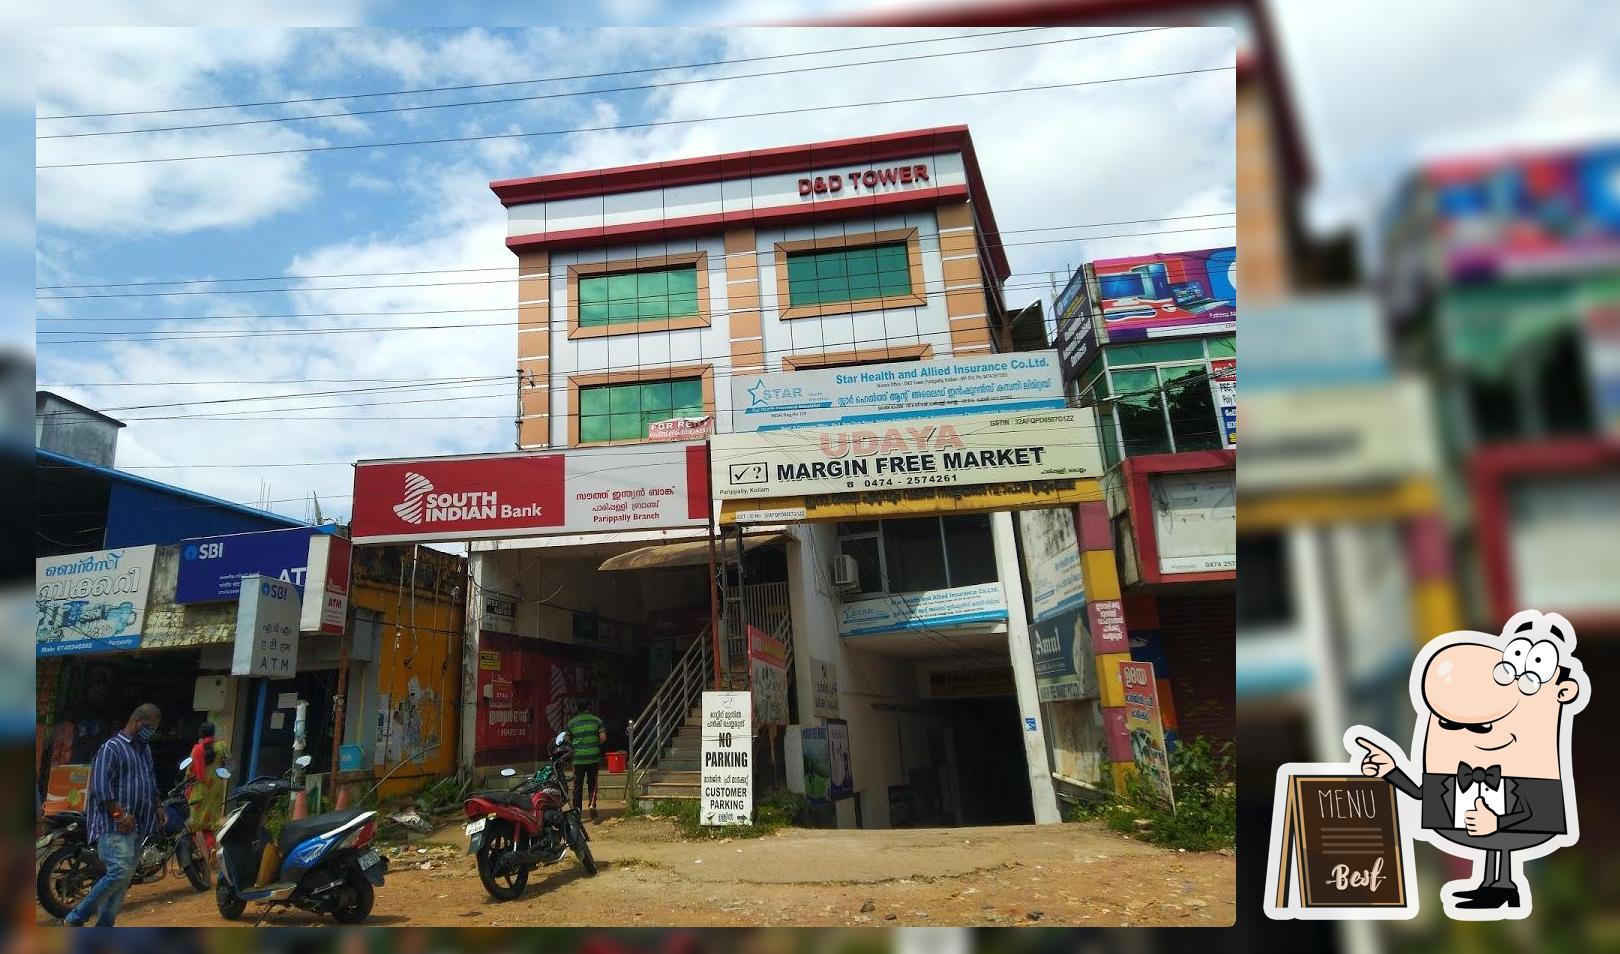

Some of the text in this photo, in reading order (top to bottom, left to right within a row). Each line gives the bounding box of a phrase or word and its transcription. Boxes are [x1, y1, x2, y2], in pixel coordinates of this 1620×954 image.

[798, 164, 929, 196] D&D TOWER
[836, 358, 1049, 385] Star Health and Allied Insurance Co.Ltd.
[763, 387, 803, 400] STAR
[651, 422, 673, 431] FOR
[819, 424, 966, 459] UDAYA
[777, 447, 1045, 481] MARGIN FREE MARKET
[864, 478, 893, 488] 0474
[907, 475, 957, 485] 2574261
[426, 491, 497, 508] SOUTH
[612, 488, 646, 501] ഇന്ത്യൻ
[649, 485, 676, 496] ബാങ്ക്
[425, 503, 542, 523] INDIAN Bank
[593, 512, 660, 524] Parippally Branch
[199, 543, 224, 560] SBI
[279, 567, 307, 586] AT
[271, 584, 287, 600] SBI
[328, 597, 342, 609] ATM
[1035, 626, 1061, 655] Amul
[718, 732, 732, 748] NO
[705, 752, 748, 768] PARKING
[705, 787, 747, 798] CUSTOMER
[710, 799, 744, 810] PARKING
